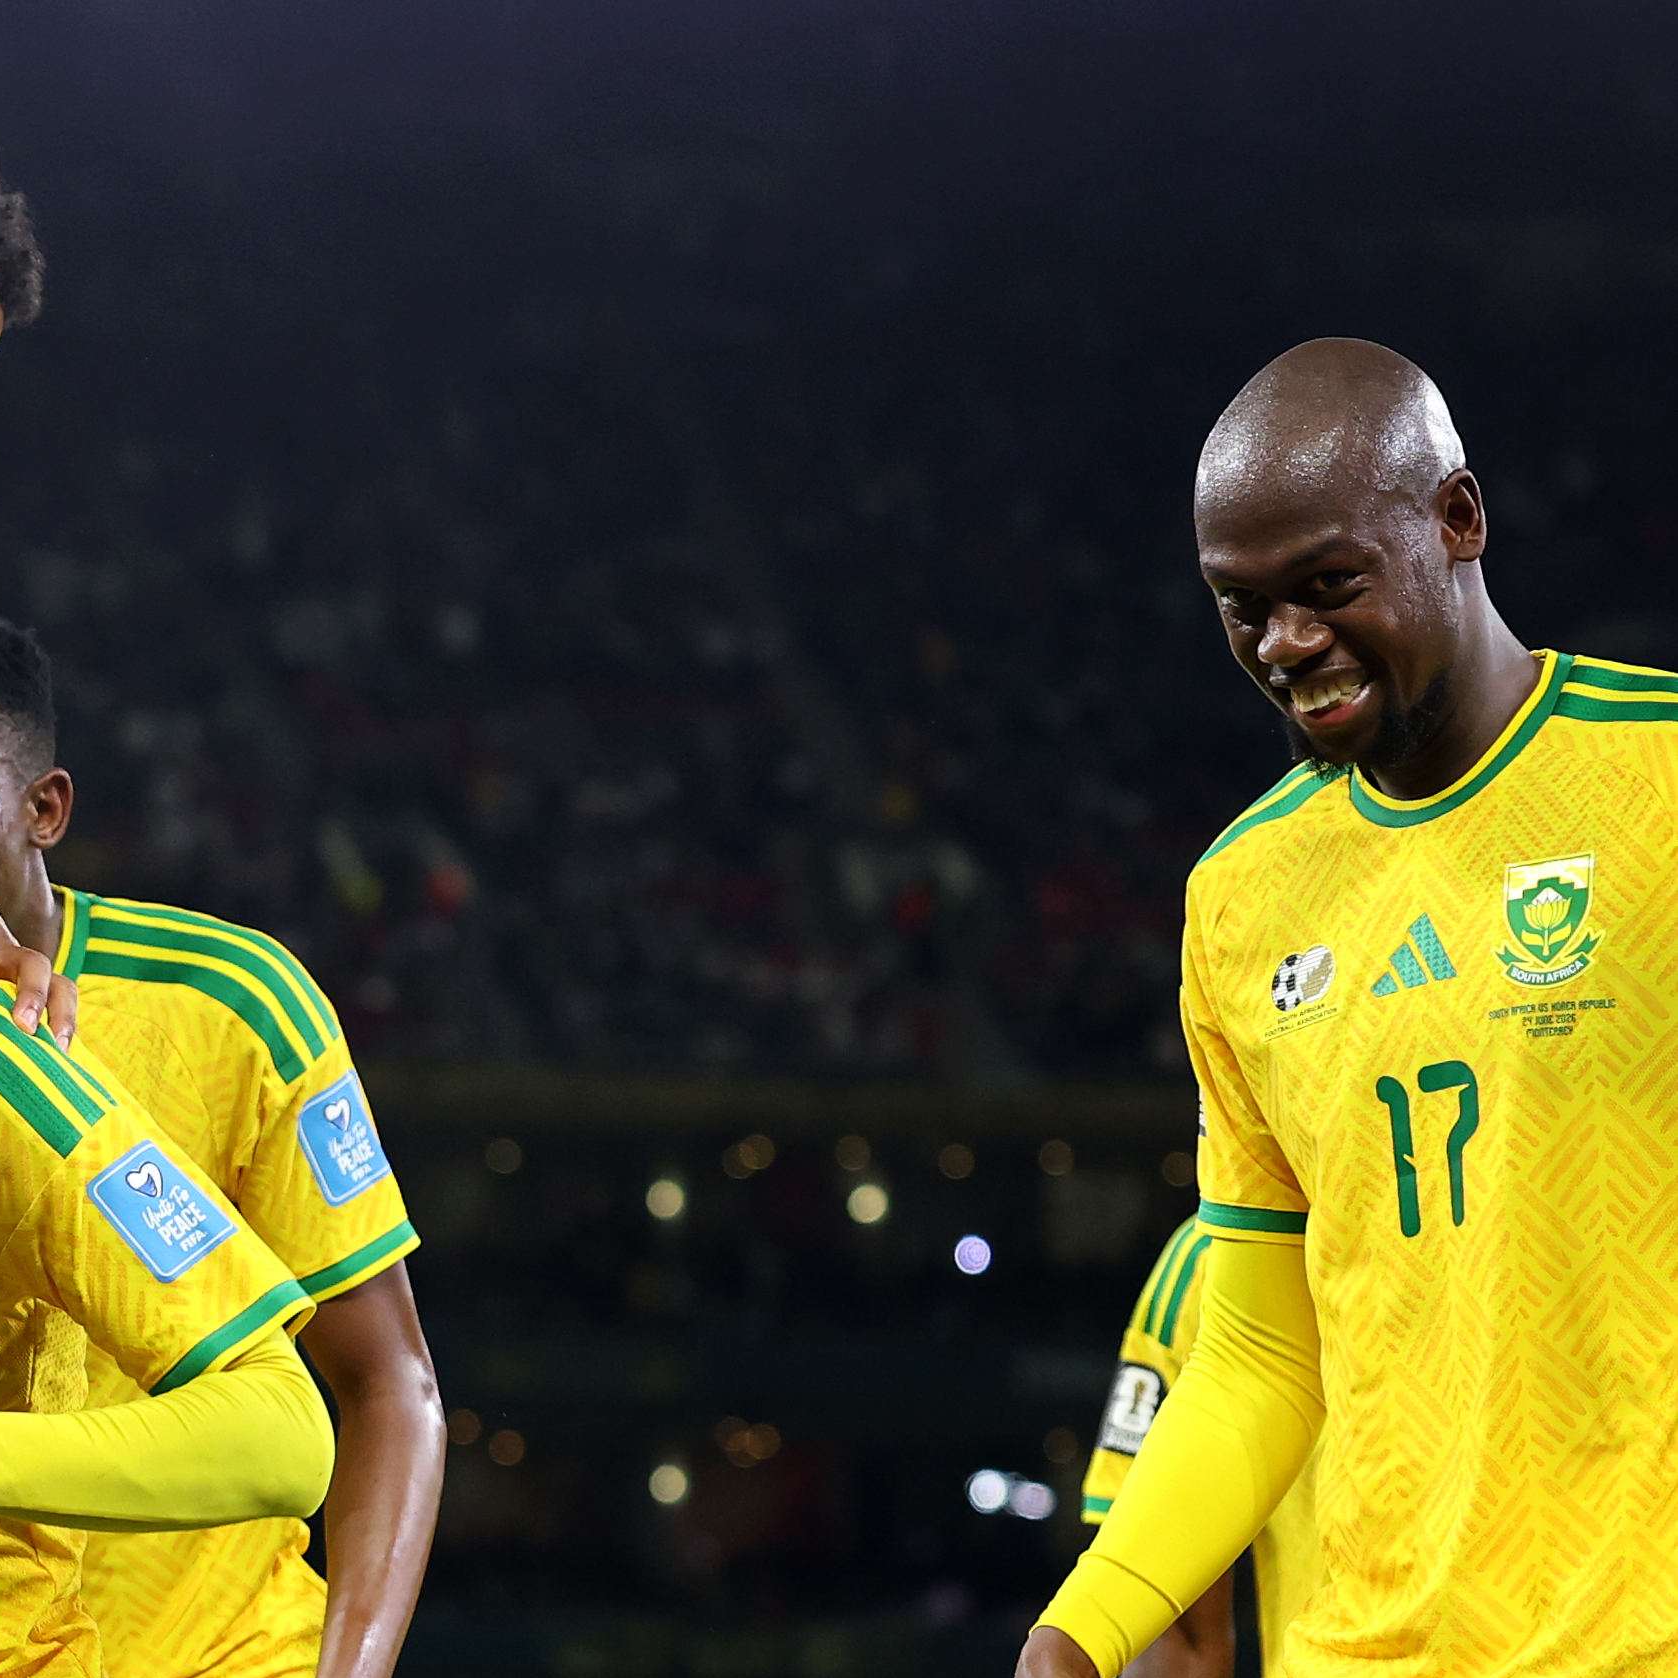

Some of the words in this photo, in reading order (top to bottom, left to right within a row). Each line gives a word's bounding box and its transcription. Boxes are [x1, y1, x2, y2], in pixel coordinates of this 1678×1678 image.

[1511, 967, 1544, 983] SOUTH
[1546, 960, 1584, 983] AFRICA
[337, 1138, 375, 1176] PEACE
[1376, 1060, 1480, 1238] 17
[157, 1202, 207, 1246] PEACE
[179, 1229, 207, 1252] FIFA
